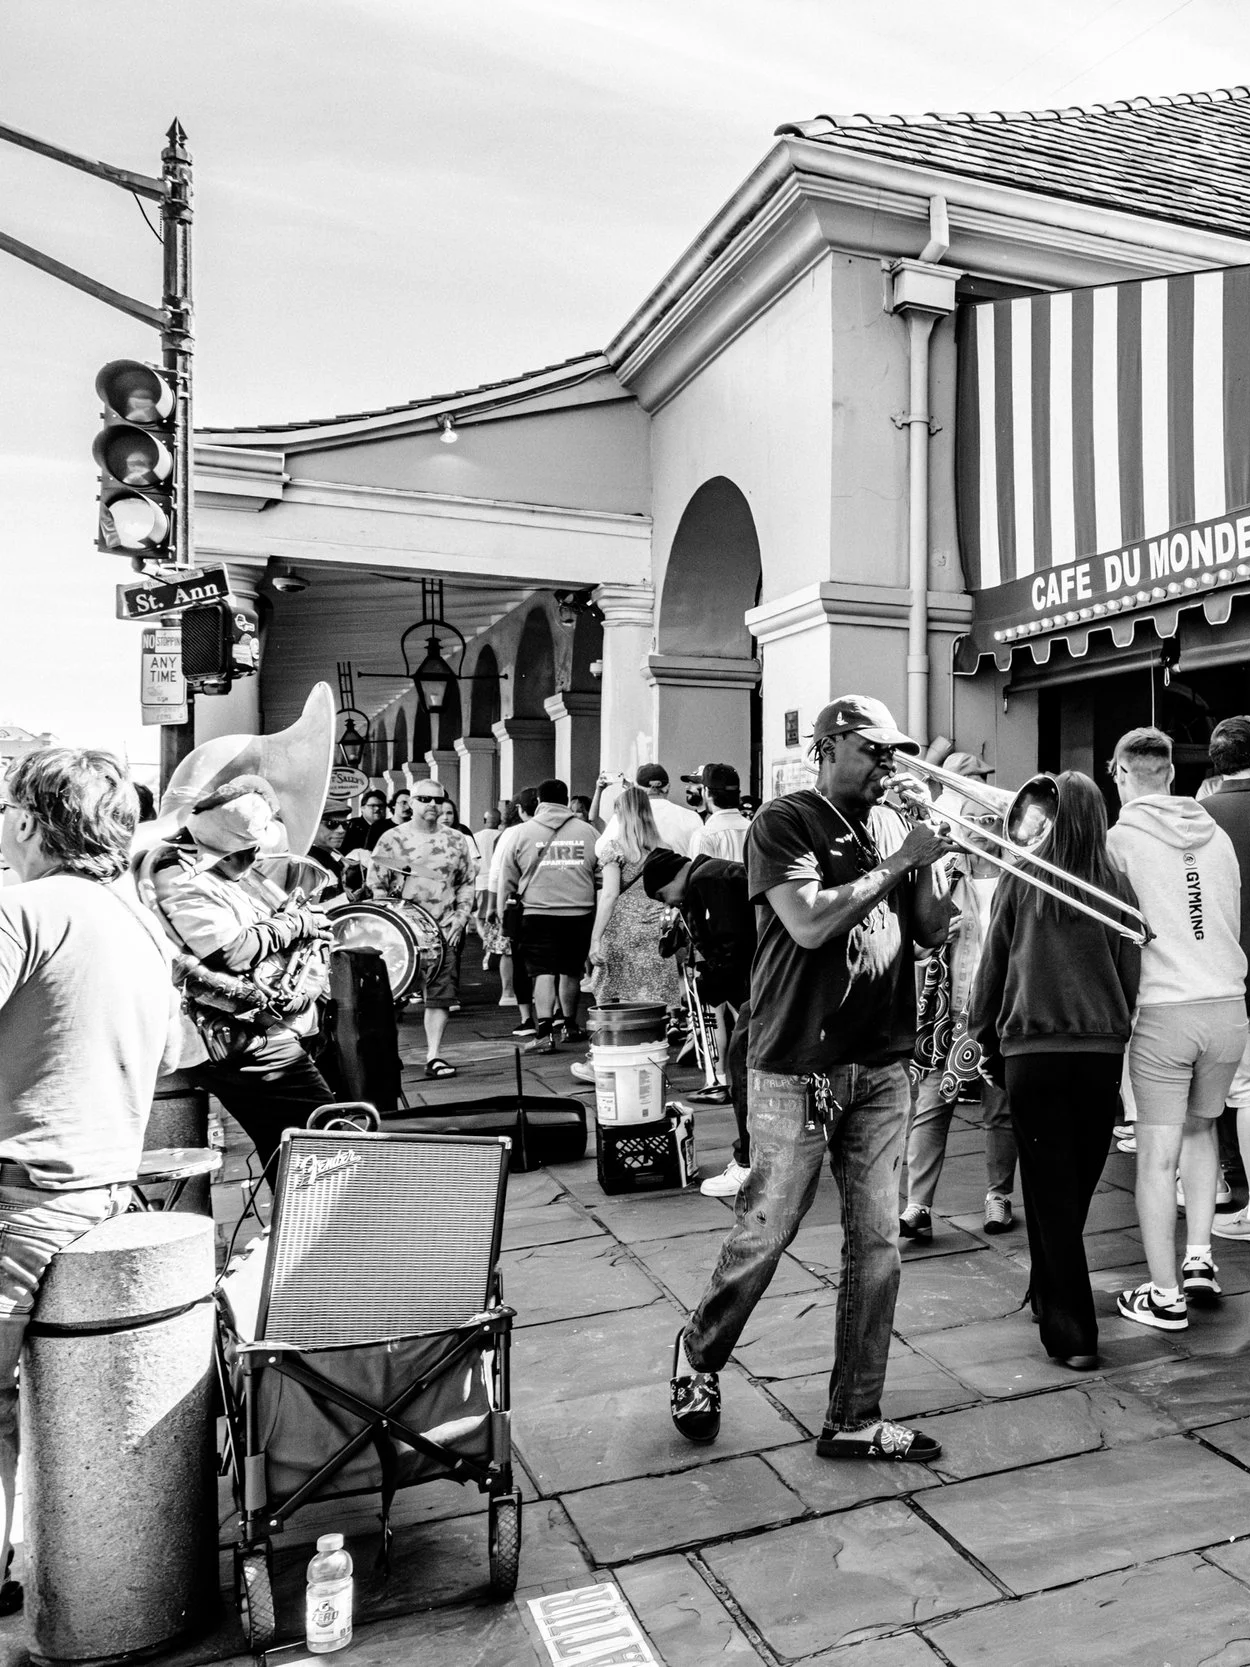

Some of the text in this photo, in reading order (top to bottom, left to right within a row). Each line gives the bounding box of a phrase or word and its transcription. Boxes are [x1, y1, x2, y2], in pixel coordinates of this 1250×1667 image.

[1031, 564, 1092, 610] CAFE
[1104, 548, 1140, 592] DU
[135, 583, 219, 612] St. Ann
[142, 633, 181, 649] NO STOPPIN
[151, 657, 177, 669] ANY
[150, 670, 177, 683] TIME
[538, 846, 584, 859] IRE
[1186, 872, 1204, 940] GYMKING
[298, 1149, 362, 1186] Fender
[311, 1610, 339, 1622] ZERO
